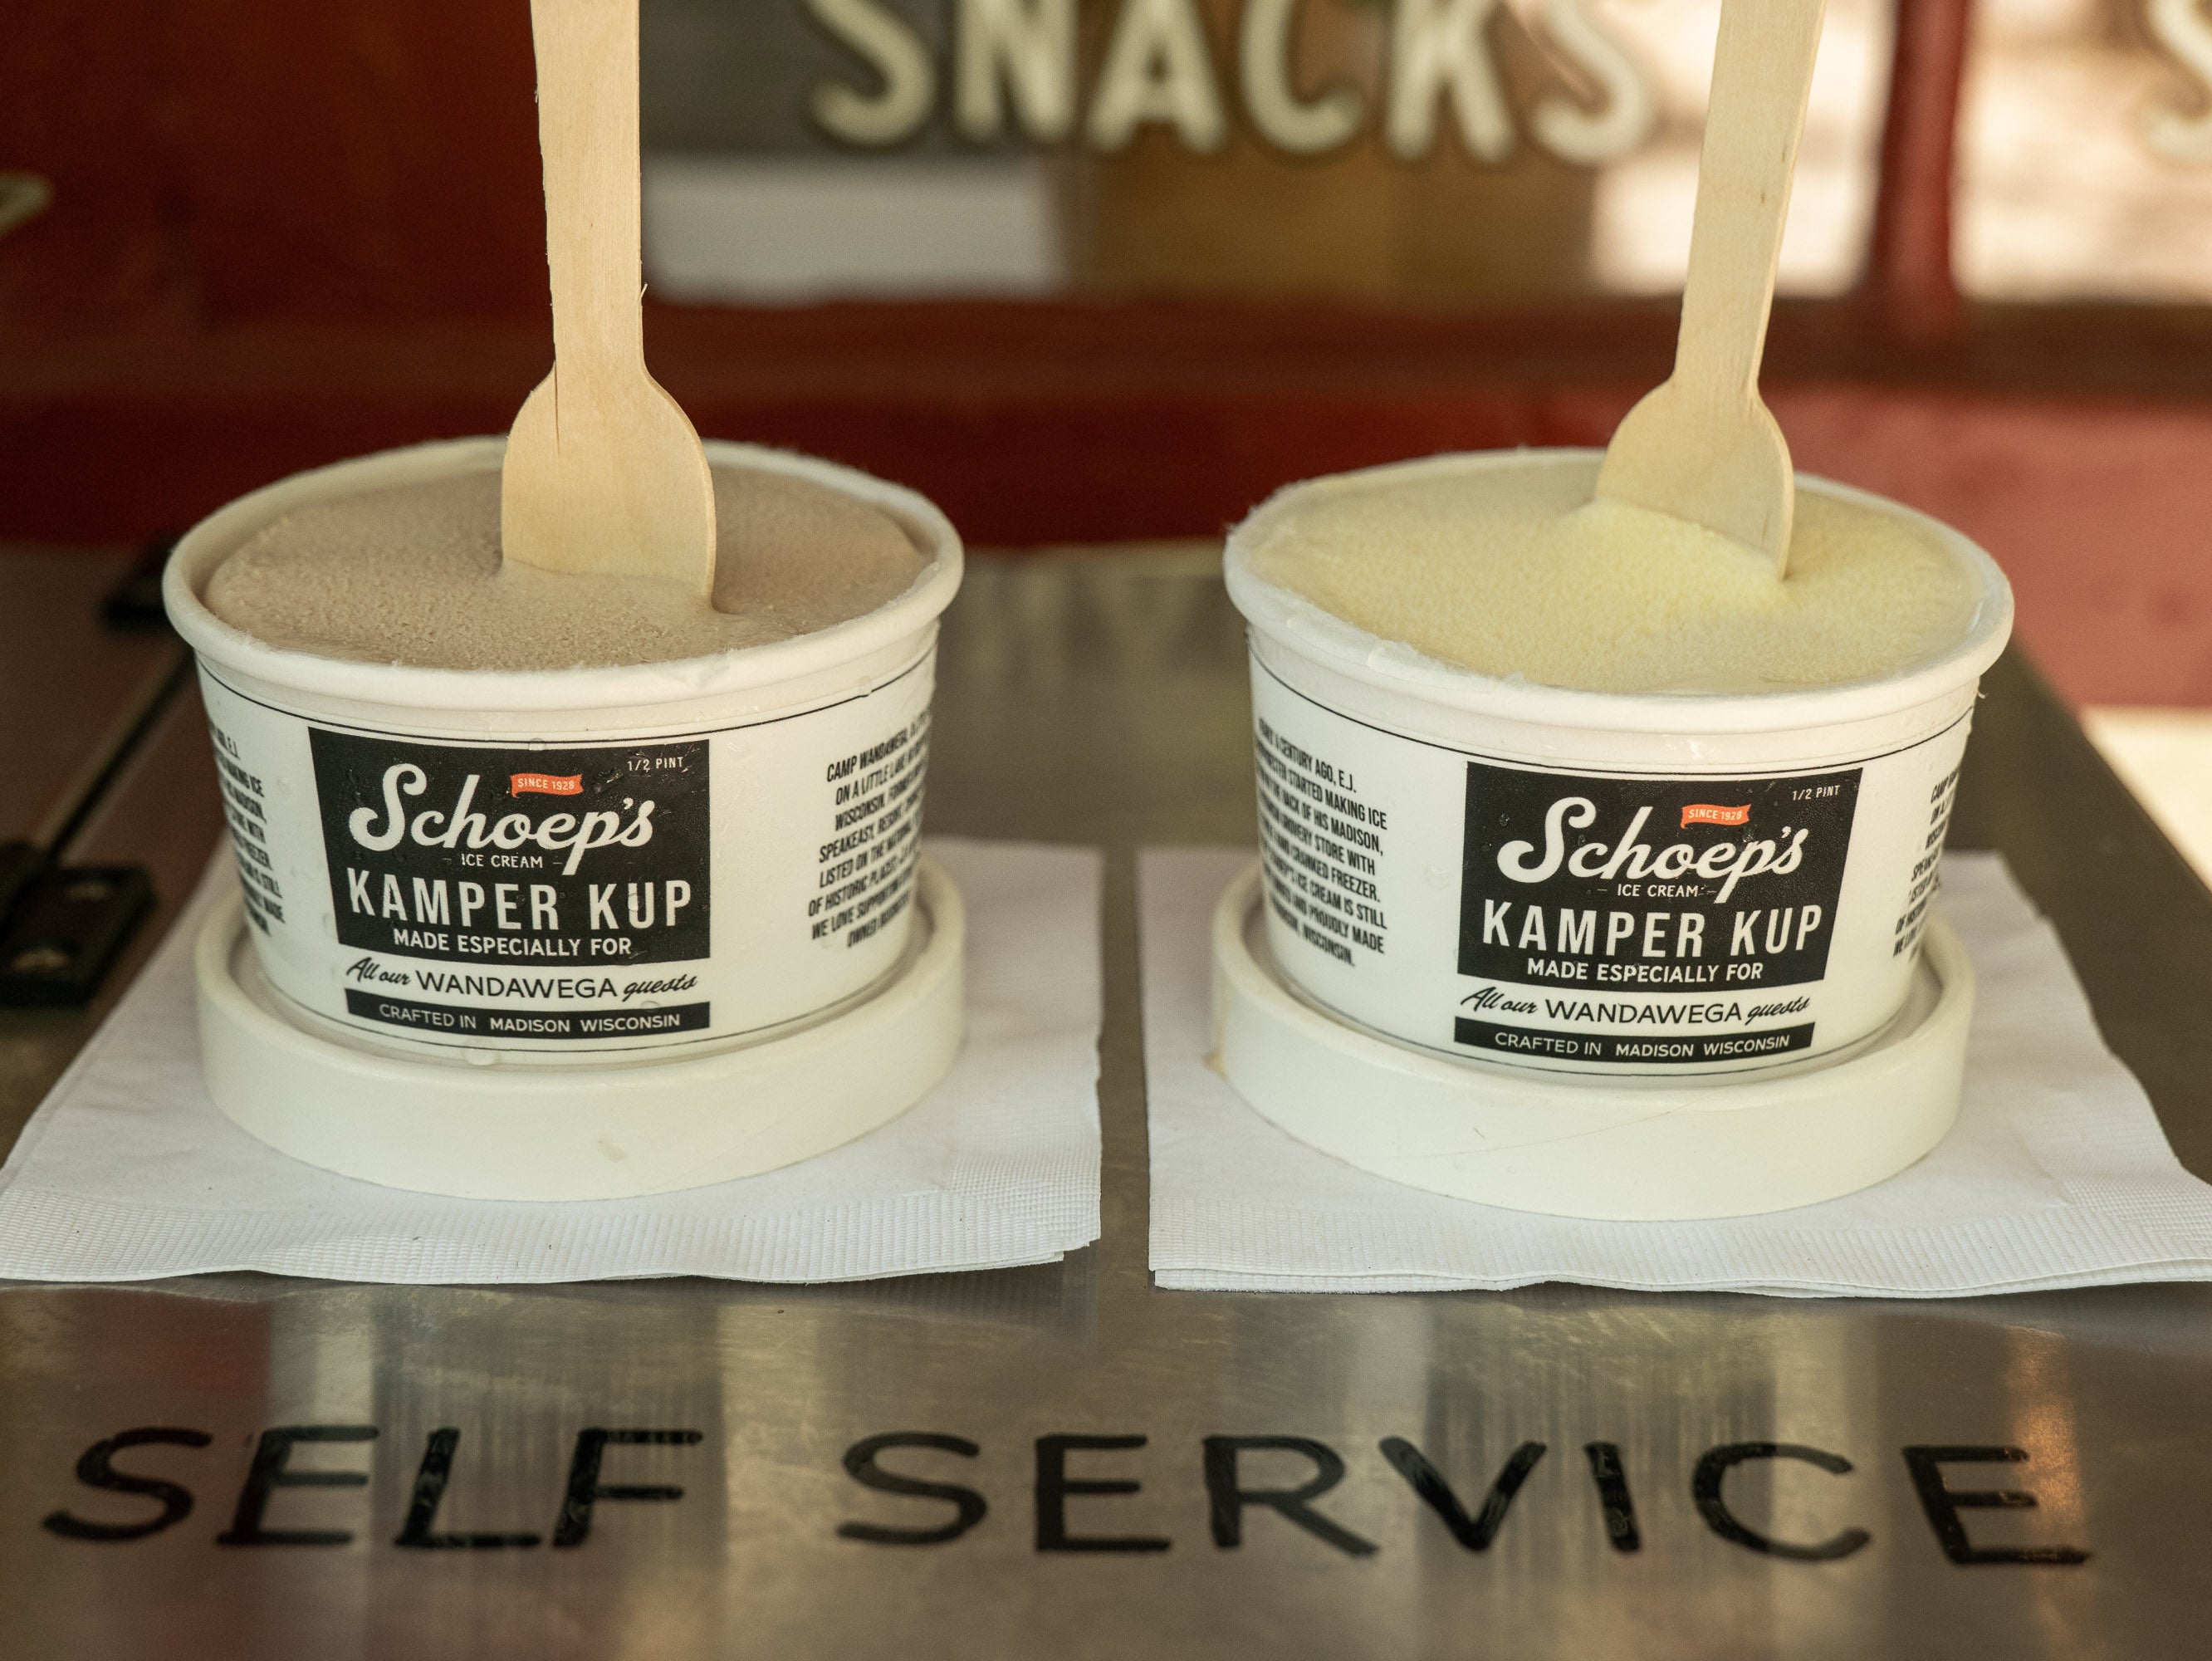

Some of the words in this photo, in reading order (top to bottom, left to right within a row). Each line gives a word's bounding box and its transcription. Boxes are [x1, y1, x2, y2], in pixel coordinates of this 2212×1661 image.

[809, 0, 1654, 164] SNACKS
[627, 759, 650, 772] 1/2
[655, 756, 684, 769] PINT
[827, 755, 858, 782] CAMP
[1315, 759, 1337, 787] AGO,
[1338, 769, 1357, 793] E.J.
[517, 777, 549, 791] SINCE
[551, 778, 575, 791] 1928
[835, 783, 850, 806] ON
[851, 779, 859, 799] A
[1792, 788, 1813, 801] 1/2
[1816, 785, 1840, 799] PINT
[349, 763, 655, 876] Schoep's
[1325, 789, 1366, 822] MAKING
[1368, 806, 1387, 830] ICE
[1688, 808, 1719, 821] SINCE
[1720, 810, 1743, 821] 1928
[1314, 808, 1329, 830] HIS
[1330, 817, 1384, 857] MADISON,
[461, 854, 484, 868] ICE
[490, 855, 543, 870] CREAM
[1314, 834, 1345, 864] STORE
[1347, 849, 1376, 876] WITH
[1497, 796, 1809, 904] Schoep's
[820, 858, 854, 889] LISTED
[1330, 867, 1381, 903] FREEZER.
[346, 867, 560, 931] KAMPER
[588, 879, 692, 931] KUP
[1309, 879, 1342, 911] CREAM
[1343, 897, 1354, 917] IS
[1355, 903, 1388, 930] STILL
[1617, 884, 1642, 897] ICE
[1647, 884, 1699, 898] CREAM
[809, 897, 824, 918] OF
[394, 929, 450, 952] MADE
[458, 934, 581, 957] ESPECIALLY
[590, 938, 632, 956] FOR
[812, 918, 829, 940] WE
[1351, 925, 1385, 954] MADE
[1482, 899, 1705, 958] KAMPER
[1730, 904, 1823, 958] KUP
[345, 957, 378, 982] All
[379, 970, 411, 987] our
[414, 970, 619, 999] WANDAWEGA
[622, 973, 698, 1002] guests
[1527, 958, 1588, 980] MADE
[1597, 963, 1720, 983] ESPECIALLY
[1725, 963, 1764, 981] FOR
[379, 1003, 454, 1027] CRAFTED
[460, 1014, 477, 1029] IN
[489, 1017, 570, 1032] MADISON
[580, 1013, 681, 1032] WISCONSIN
[1460, 987, 1500, 1012] All
[1500, 1000, 1538, 1017] our
[1544, 999, 1742, 1024] WANDAWEGA
[1745, 995, 1811, 1026] guests
[1495, 1031, 1578, 1054] CRAFTED
[1583, 1041, 1602, 1056] IN
[1615, 1043, 1694, 1058] MADISON
[1703, 1035, 1789, 1056] WISCONSIN
[41, 1425, 703, 1550] SELF
[835, 1430, 2092, 1567] SERVICE
